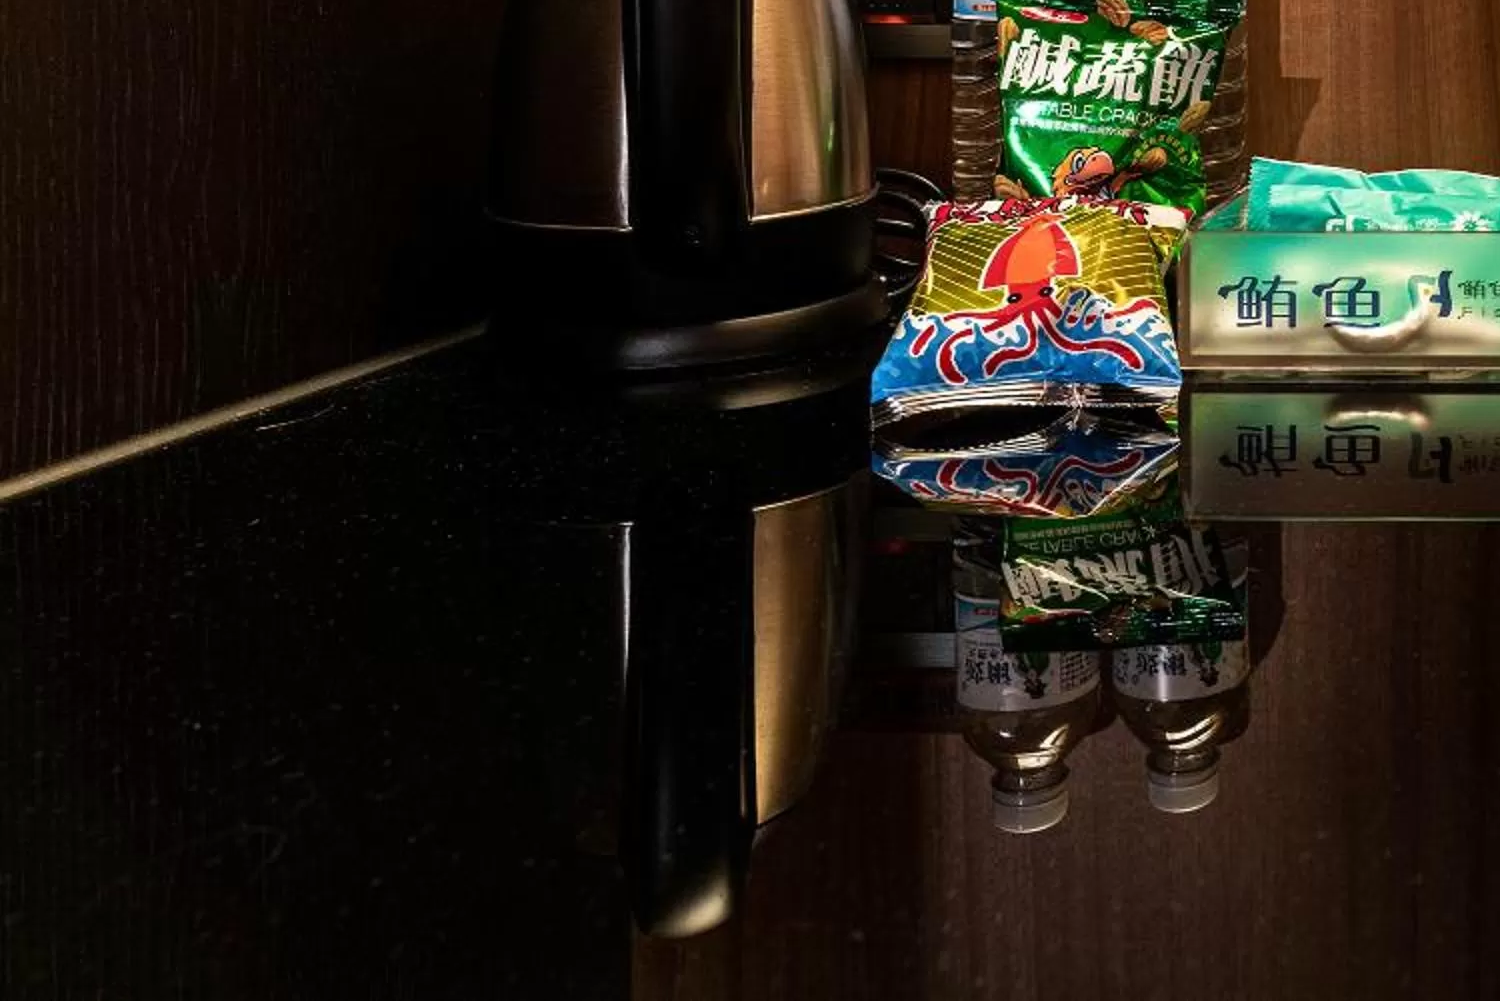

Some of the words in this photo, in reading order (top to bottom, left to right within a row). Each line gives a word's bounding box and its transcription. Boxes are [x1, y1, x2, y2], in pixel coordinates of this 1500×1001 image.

[1000, 28, 1218, 109] 鹹蔬餅
[1217, 275, 1381, 328] 鮪魚
